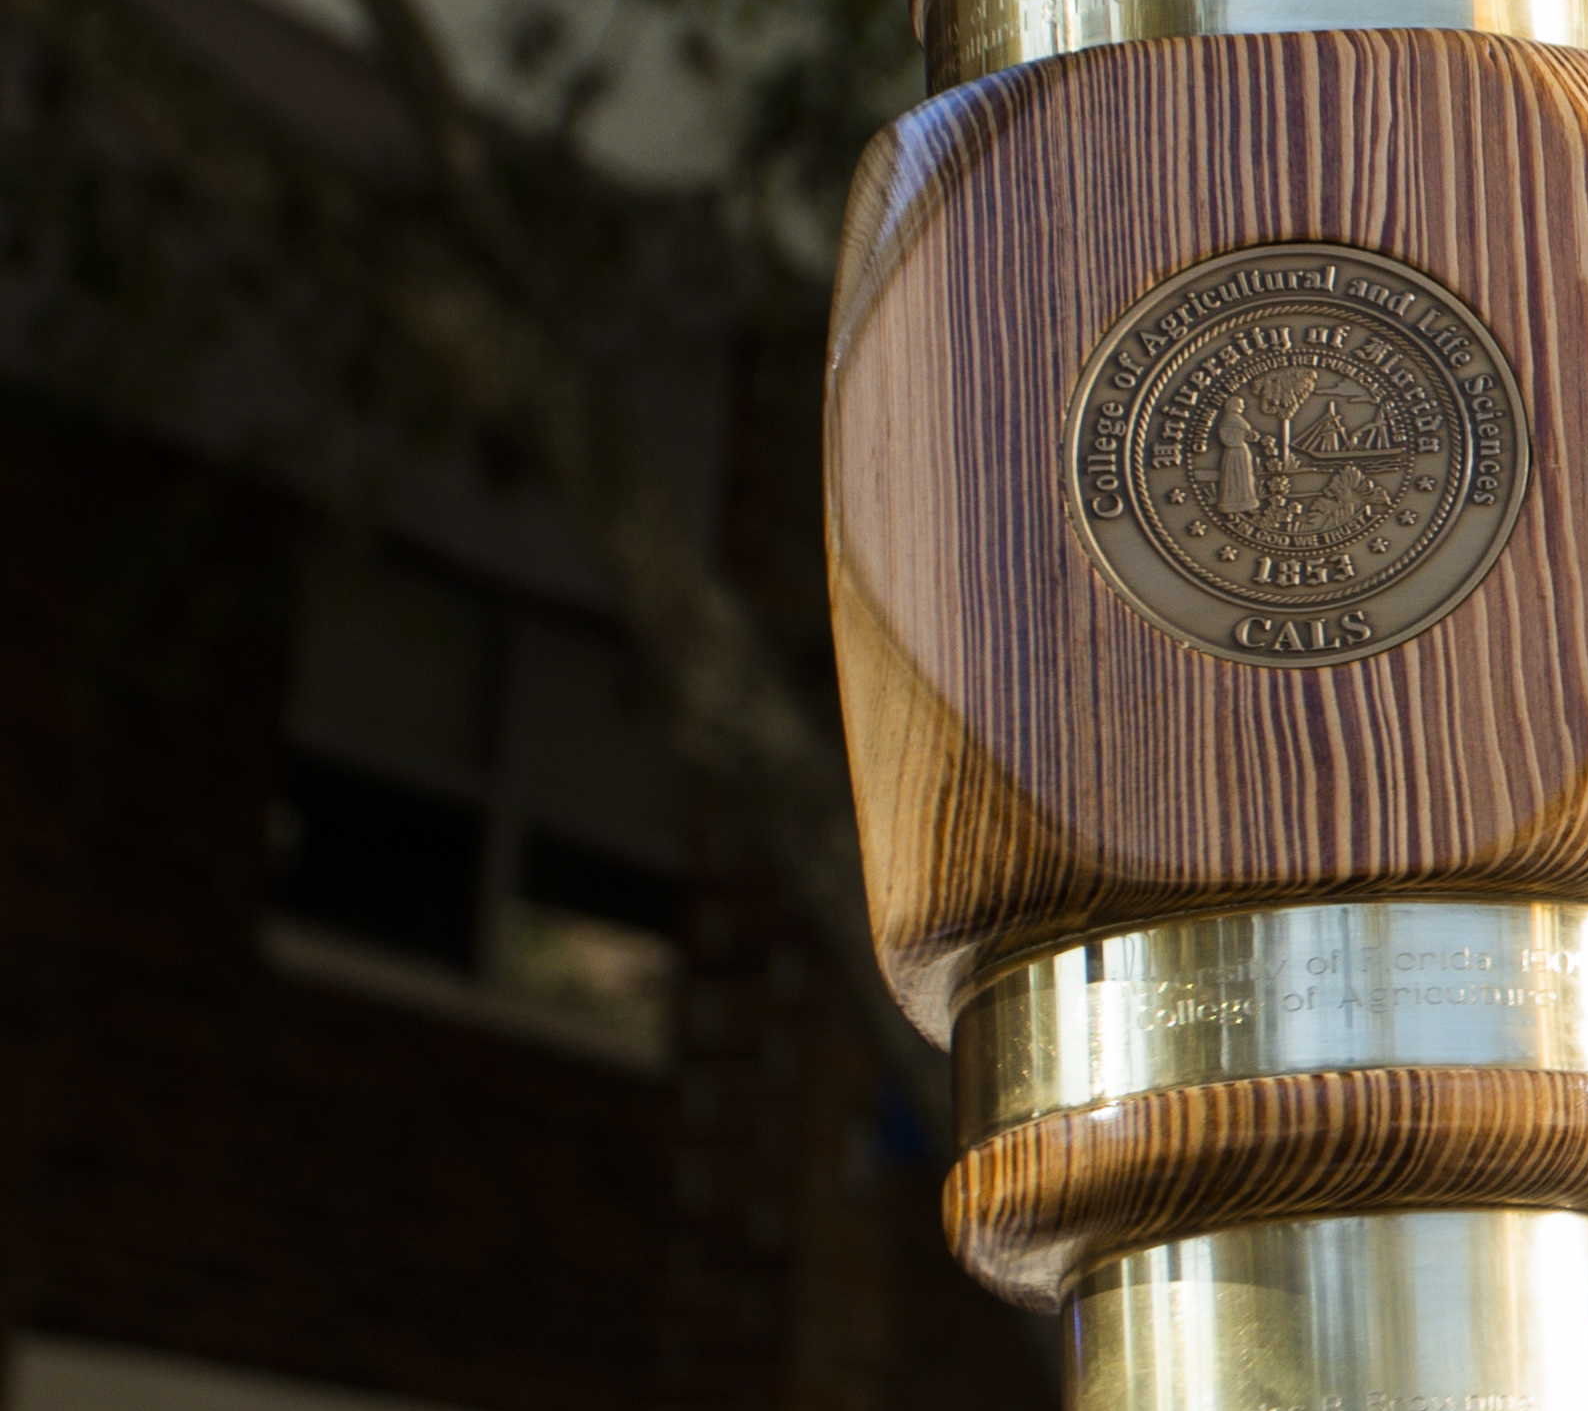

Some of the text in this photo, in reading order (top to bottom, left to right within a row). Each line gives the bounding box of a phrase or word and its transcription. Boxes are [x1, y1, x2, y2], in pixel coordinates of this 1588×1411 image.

[1086, 265, 1506, 519] College of Agricultural and Life Sciences
[1151, 325, 1443, 470] University of Florida
[1256, 529, 1291, 547] GOD
[1322, 515, 1369, 543] TRUST
[1253, 554, 1355, 587] 1853
[1234, 610, 1372, 653] CALS
[1306, 948, 1343, 976] of
[1136, 981, 1558, 1032] College of Agriculture
